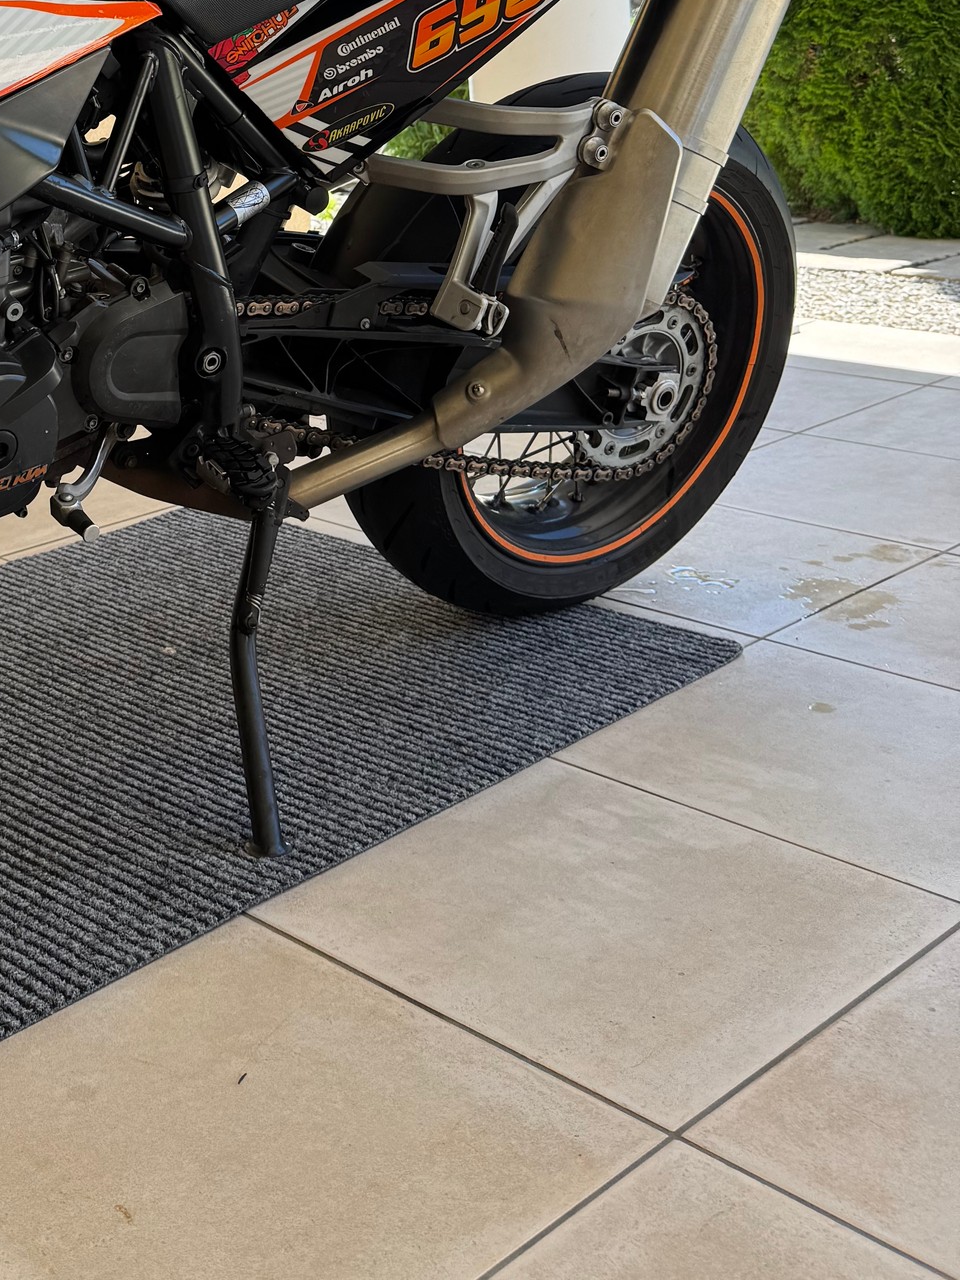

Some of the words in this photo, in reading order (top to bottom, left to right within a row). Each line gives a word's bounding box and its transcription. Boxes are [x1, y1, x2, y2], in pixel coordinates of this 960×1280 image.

[336, 16, 402, 57] Continental
[335, 45, 384, 74] brembo
[318, 68, 374, 103] Airoh
[12, 464, 48, 487] KTM
